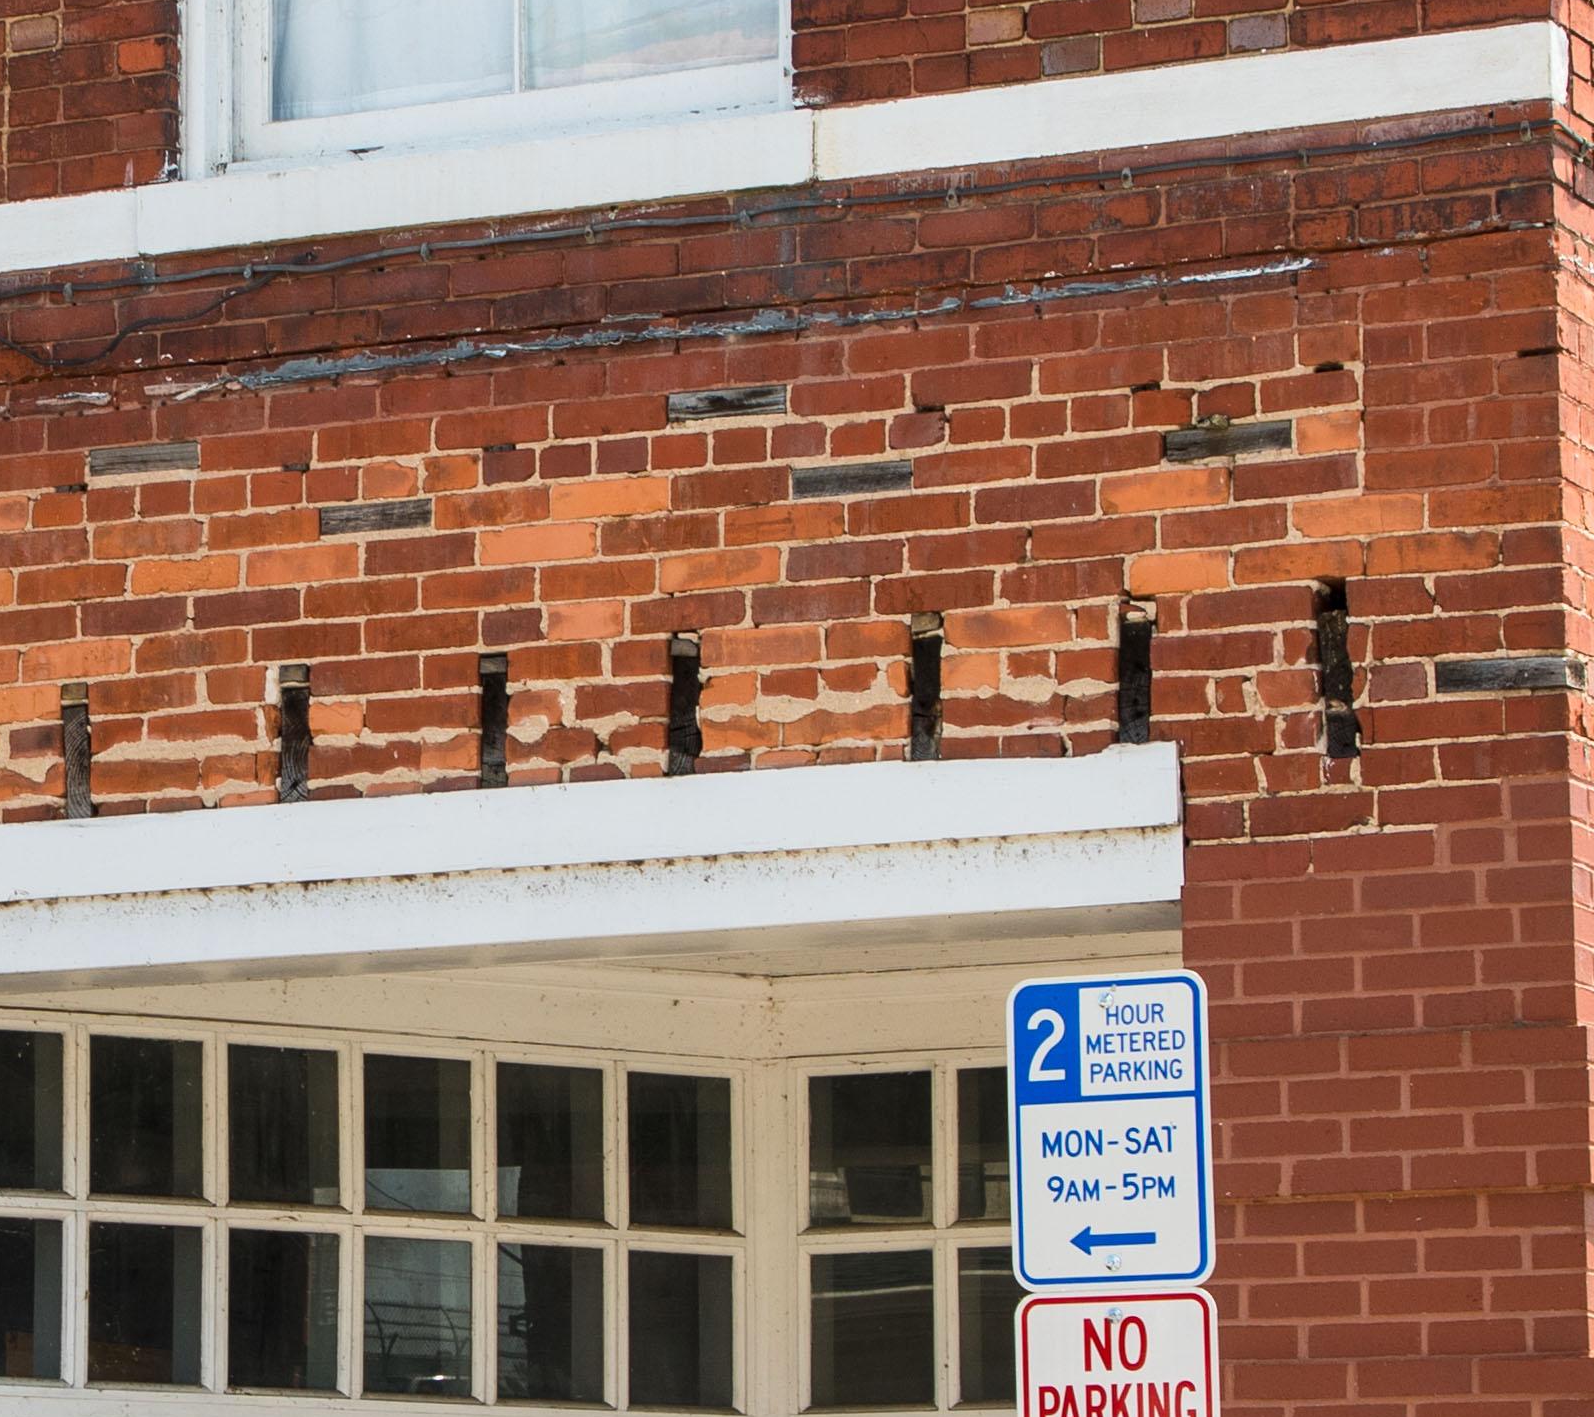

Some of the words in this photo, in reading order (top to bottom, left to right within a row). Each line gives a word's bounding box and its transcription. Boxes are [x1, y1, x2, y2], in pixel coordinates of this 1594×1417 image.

[1105, 1003, 1164, 1026] HOUR
[1027, 1008, 1066, 1082] 2
[1086, 1030, 1186, 1055] METERED
[1090, 1058, 1183, 1083] PARKING
[1083, 1316, 1148, 1372] NO
